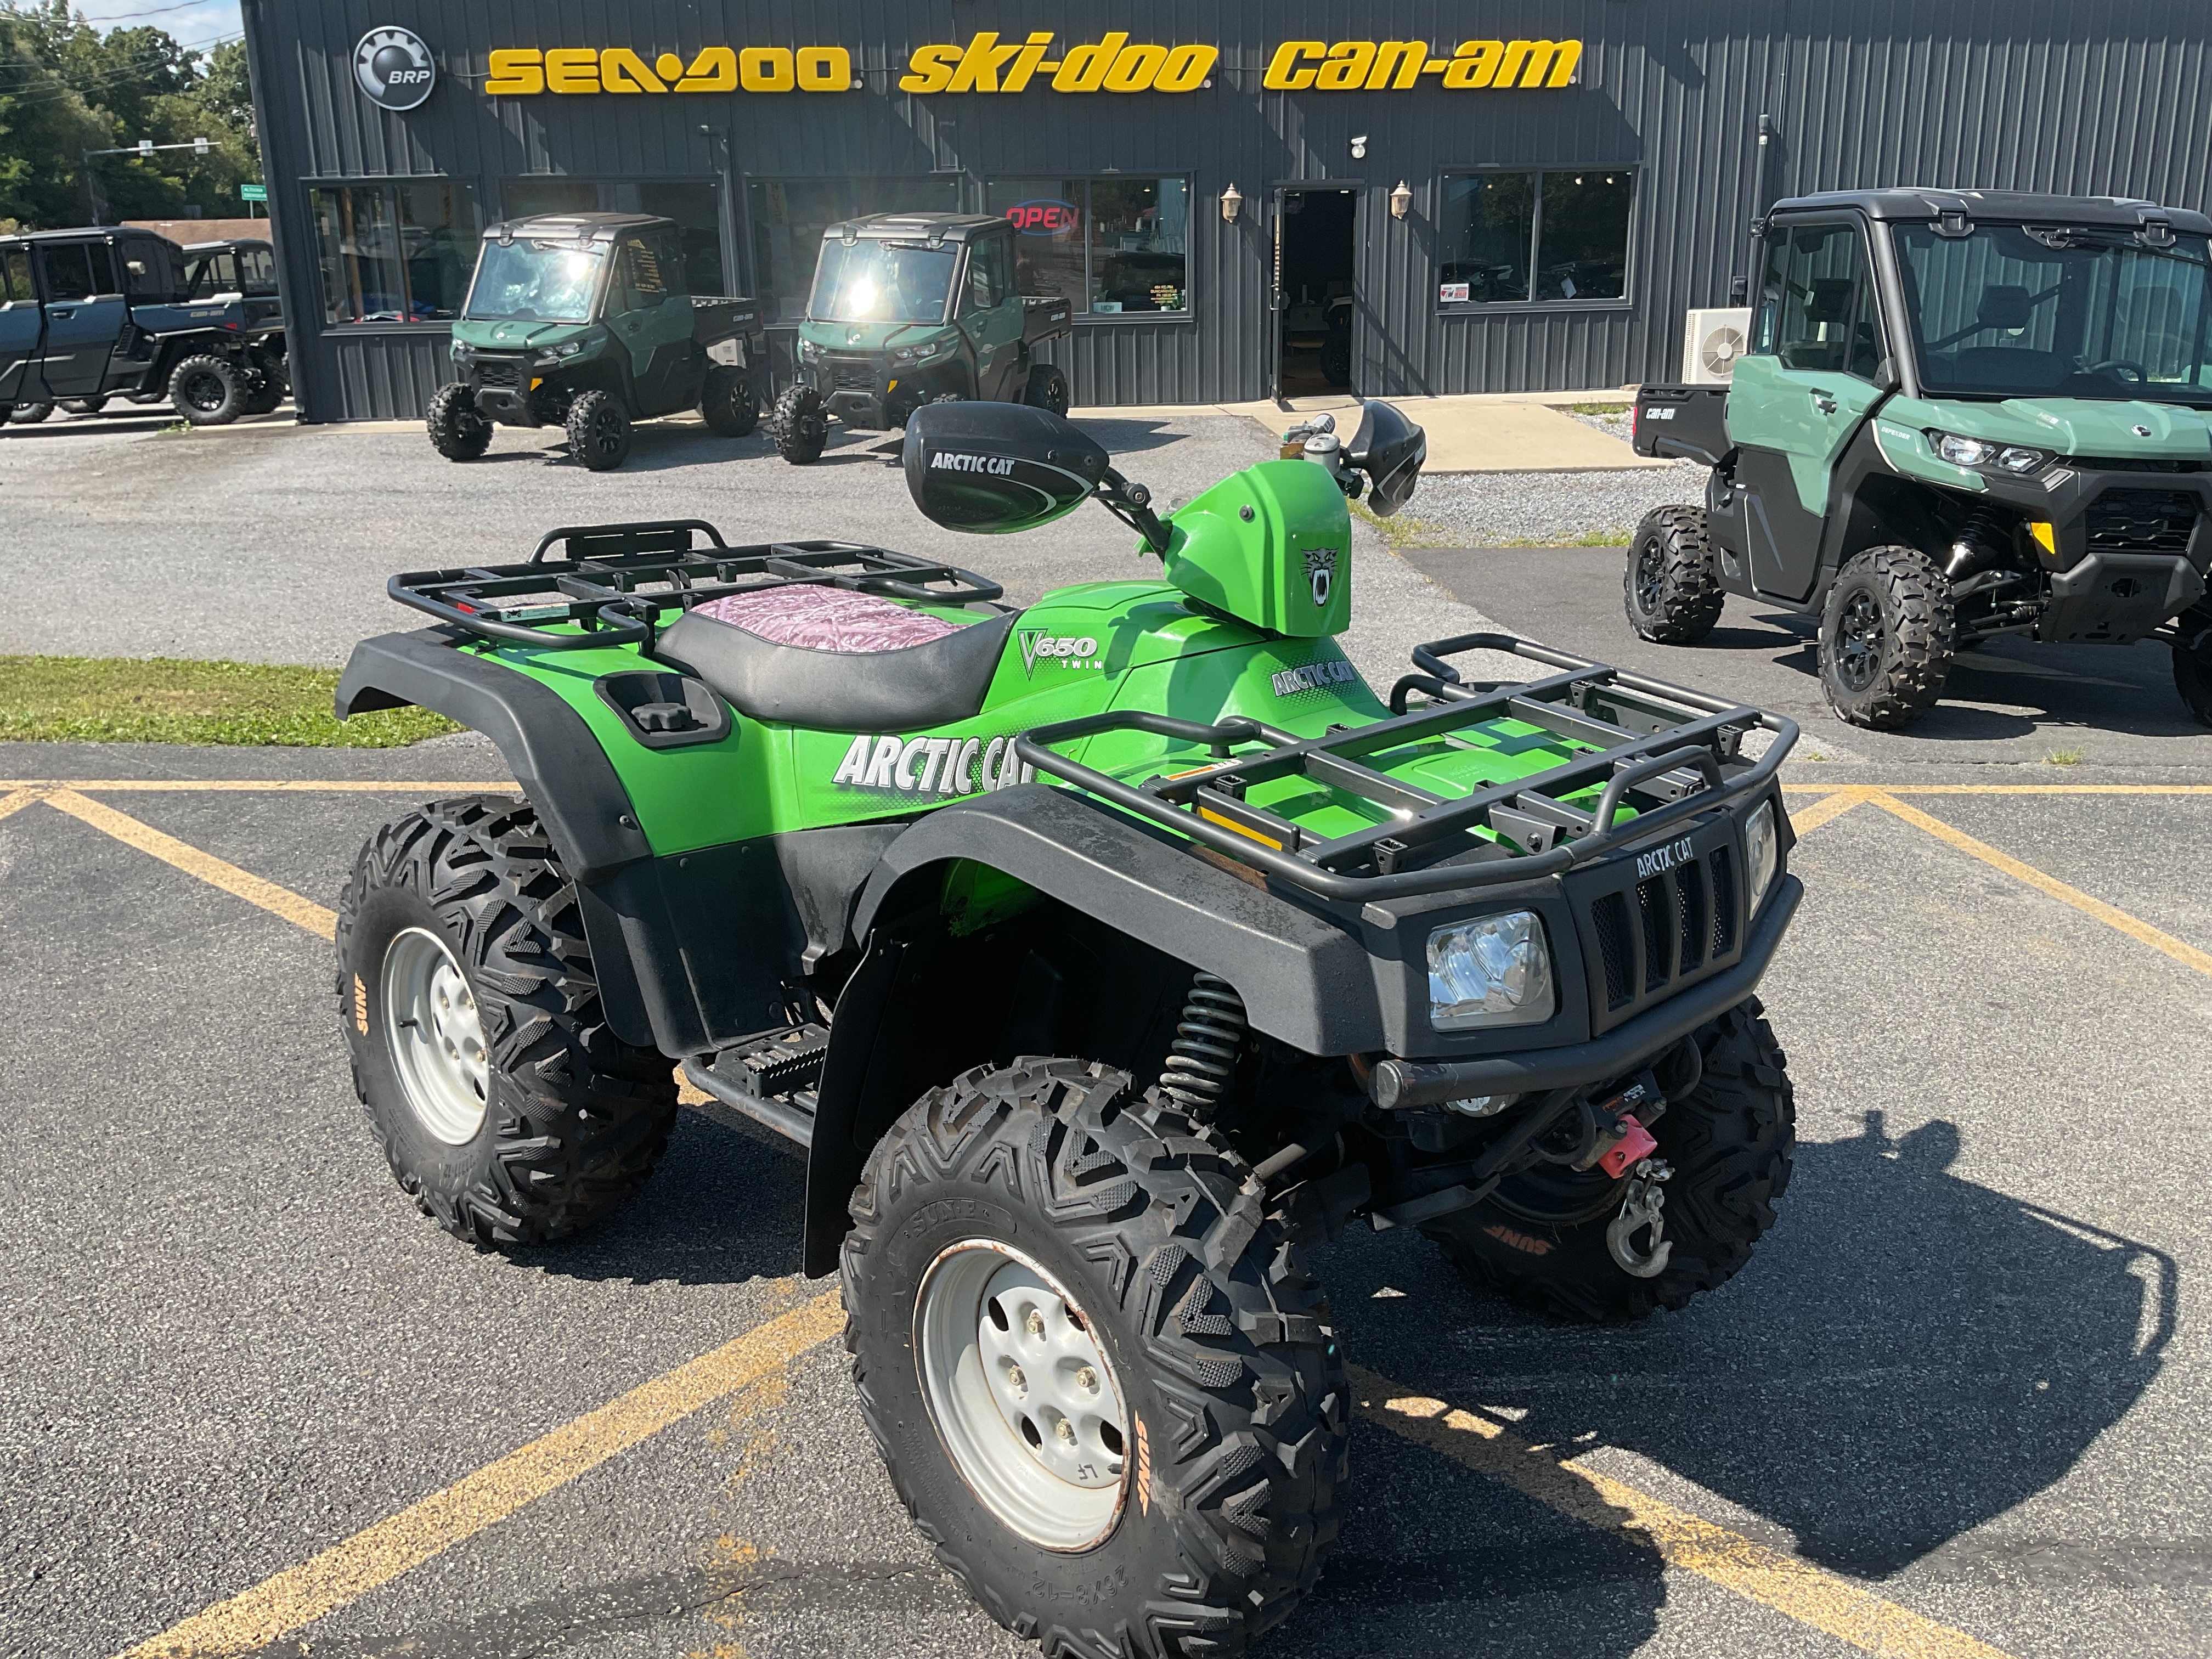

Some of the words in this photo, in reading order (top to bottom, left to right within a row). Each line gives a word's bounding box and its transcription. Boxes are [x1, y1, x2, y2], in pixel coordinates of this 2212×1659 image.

[388, 70, 430, 84] BRP
[899, 32, 1219, 93] ski-doo
[1263, 40, 1583, 90] can-am
[1006, 207, 1079, 228] OPEN
[1645, 408, 1675, 420] can-am
[1881, 426, 1910, 440] DEFENDER
[930, 452, 986, 473] ARCTIC
[987, 458, 1015, 476] CAT
[1061, 660, 1102, 669] TWIN
[1271, 664, 1331, 697] ARCTIC
[1328, 661, 1355, 682] CAT
[832, 735, 980, 793] ARCTIC
[1637, 844, 1675, 878] ARCTIC
[1674, 836, 1693, 862] CAT
[1135, 1409, 1150, 1517] SUNF
